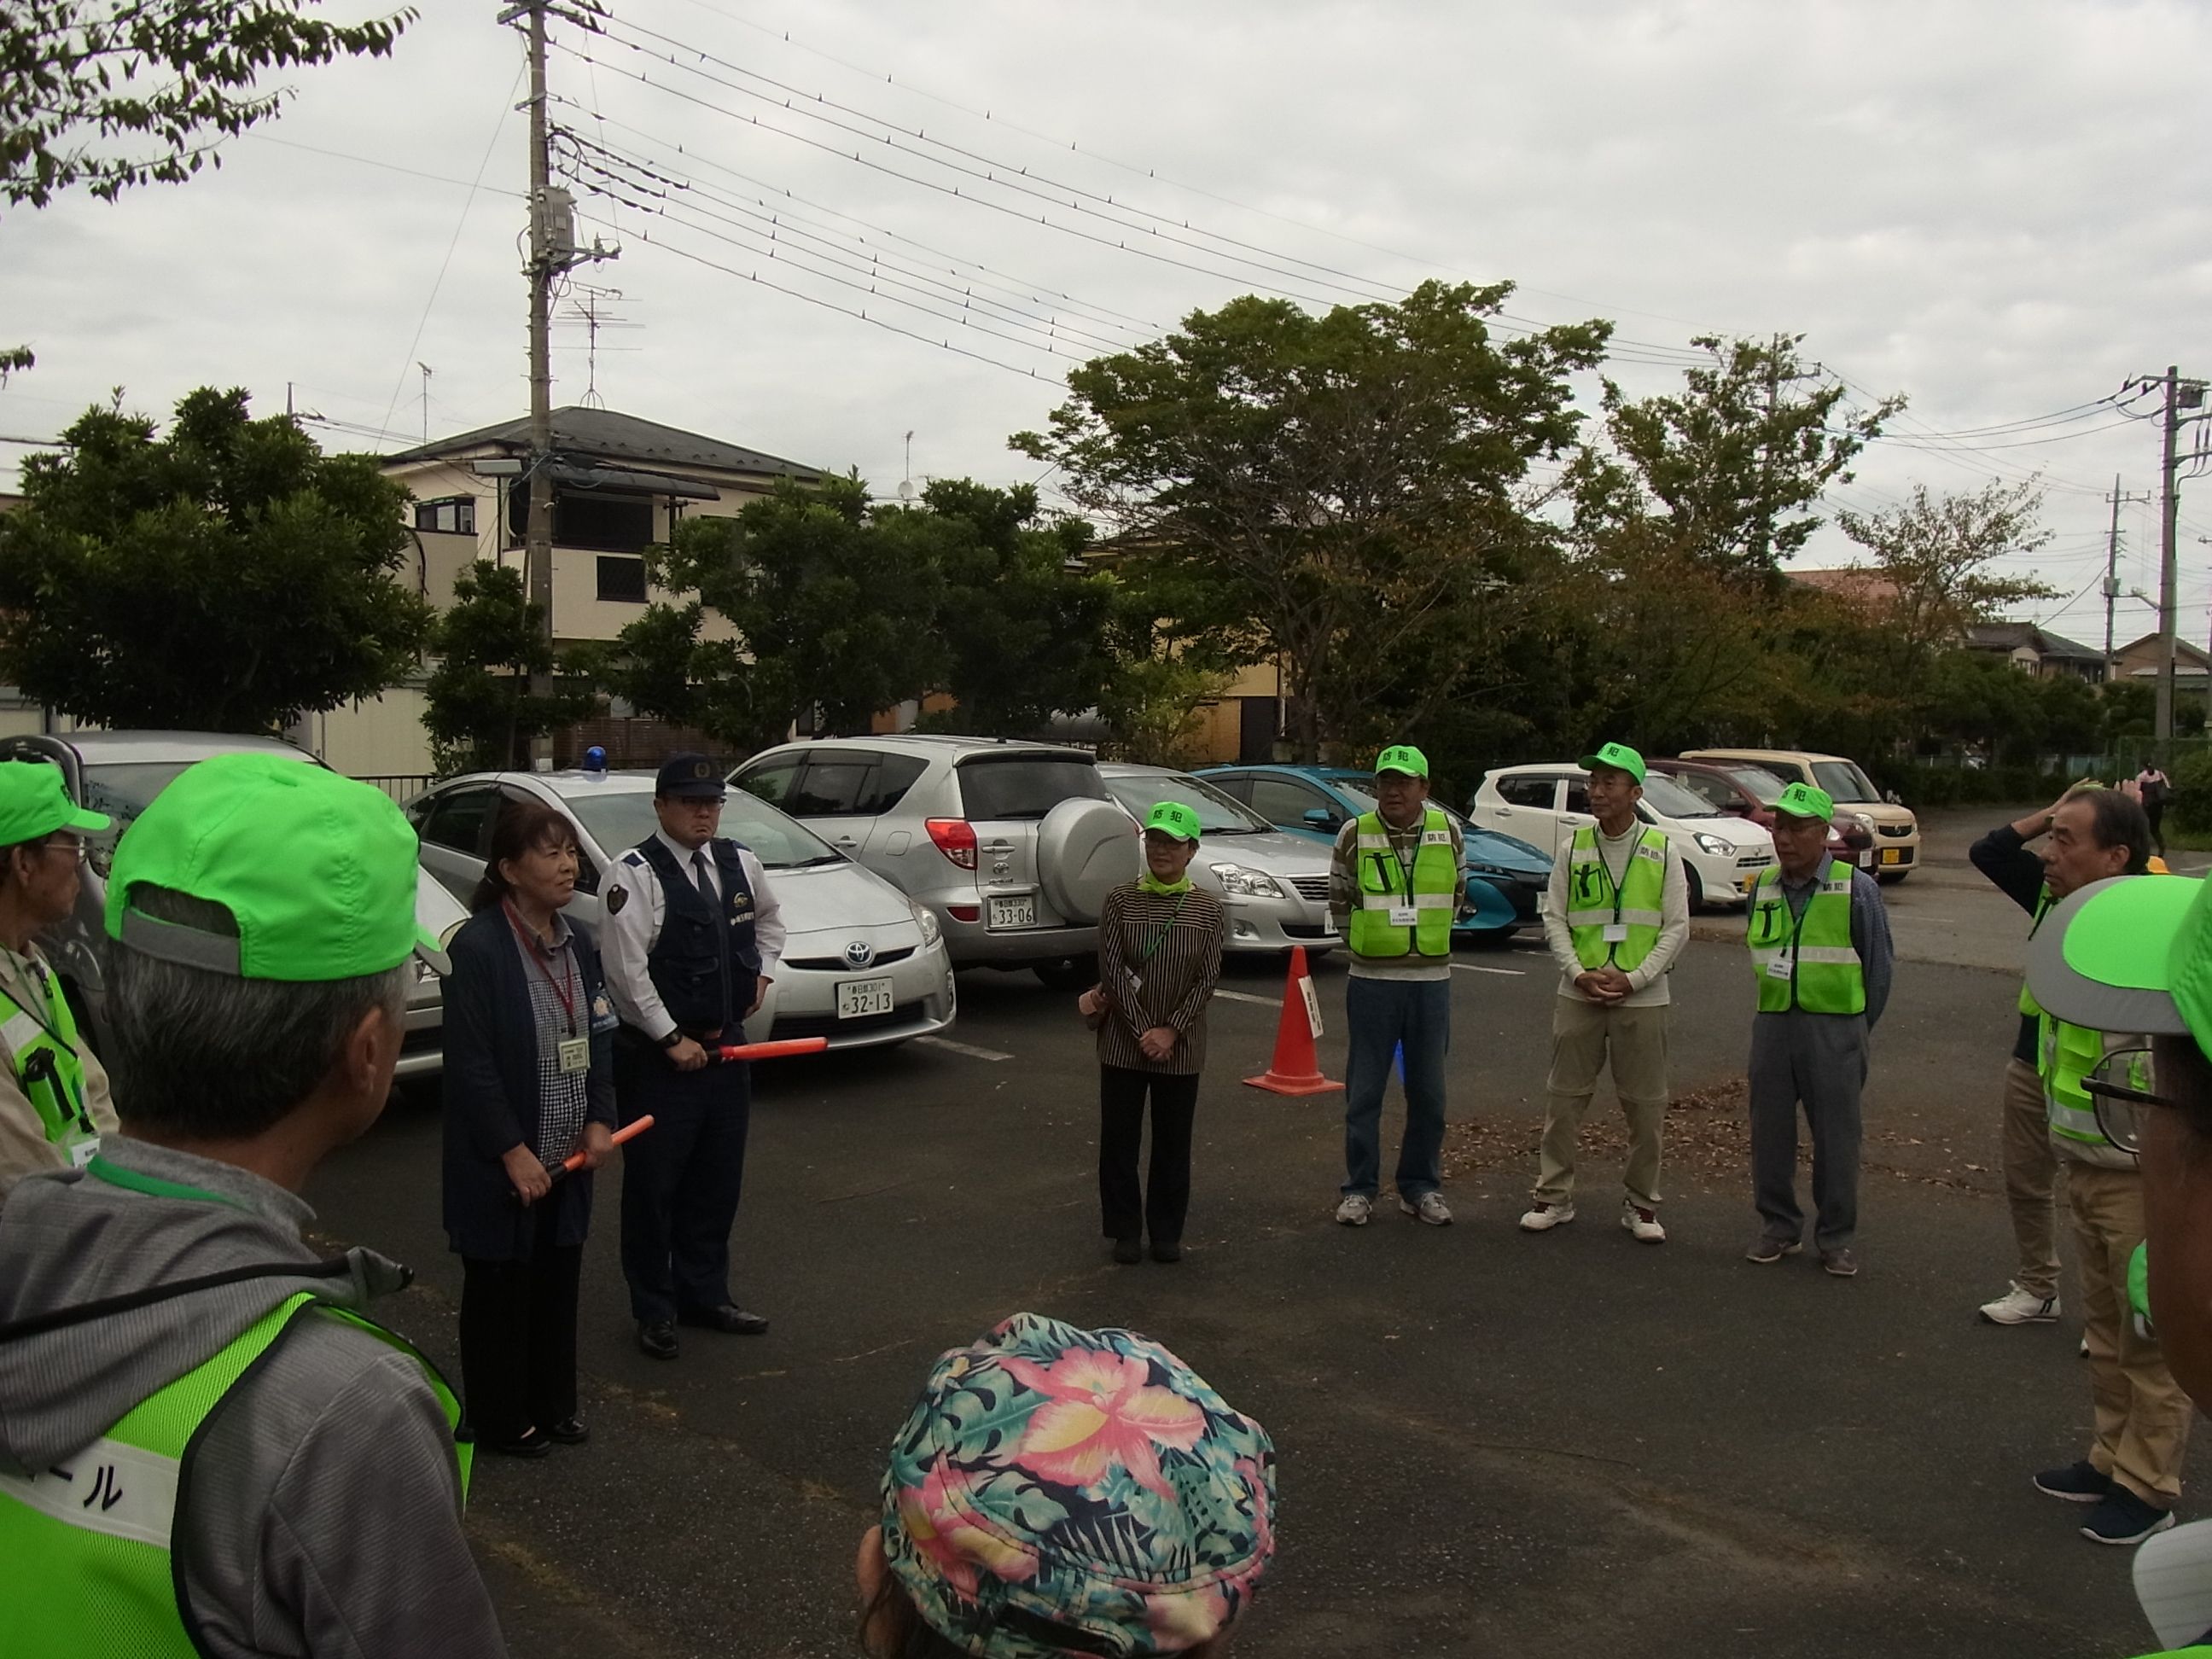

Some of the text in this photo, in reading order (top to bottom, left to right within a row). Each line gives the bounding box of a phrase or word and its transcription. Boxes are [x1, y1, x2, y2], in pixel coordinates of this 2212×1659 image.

[1382, 750, 1409, 762] 防犯
[1153, 809, 1182, 823] 防犯
[1427, 833, 1446, 842] 防犯
[1823, 882, 1843, 892] 防犯
